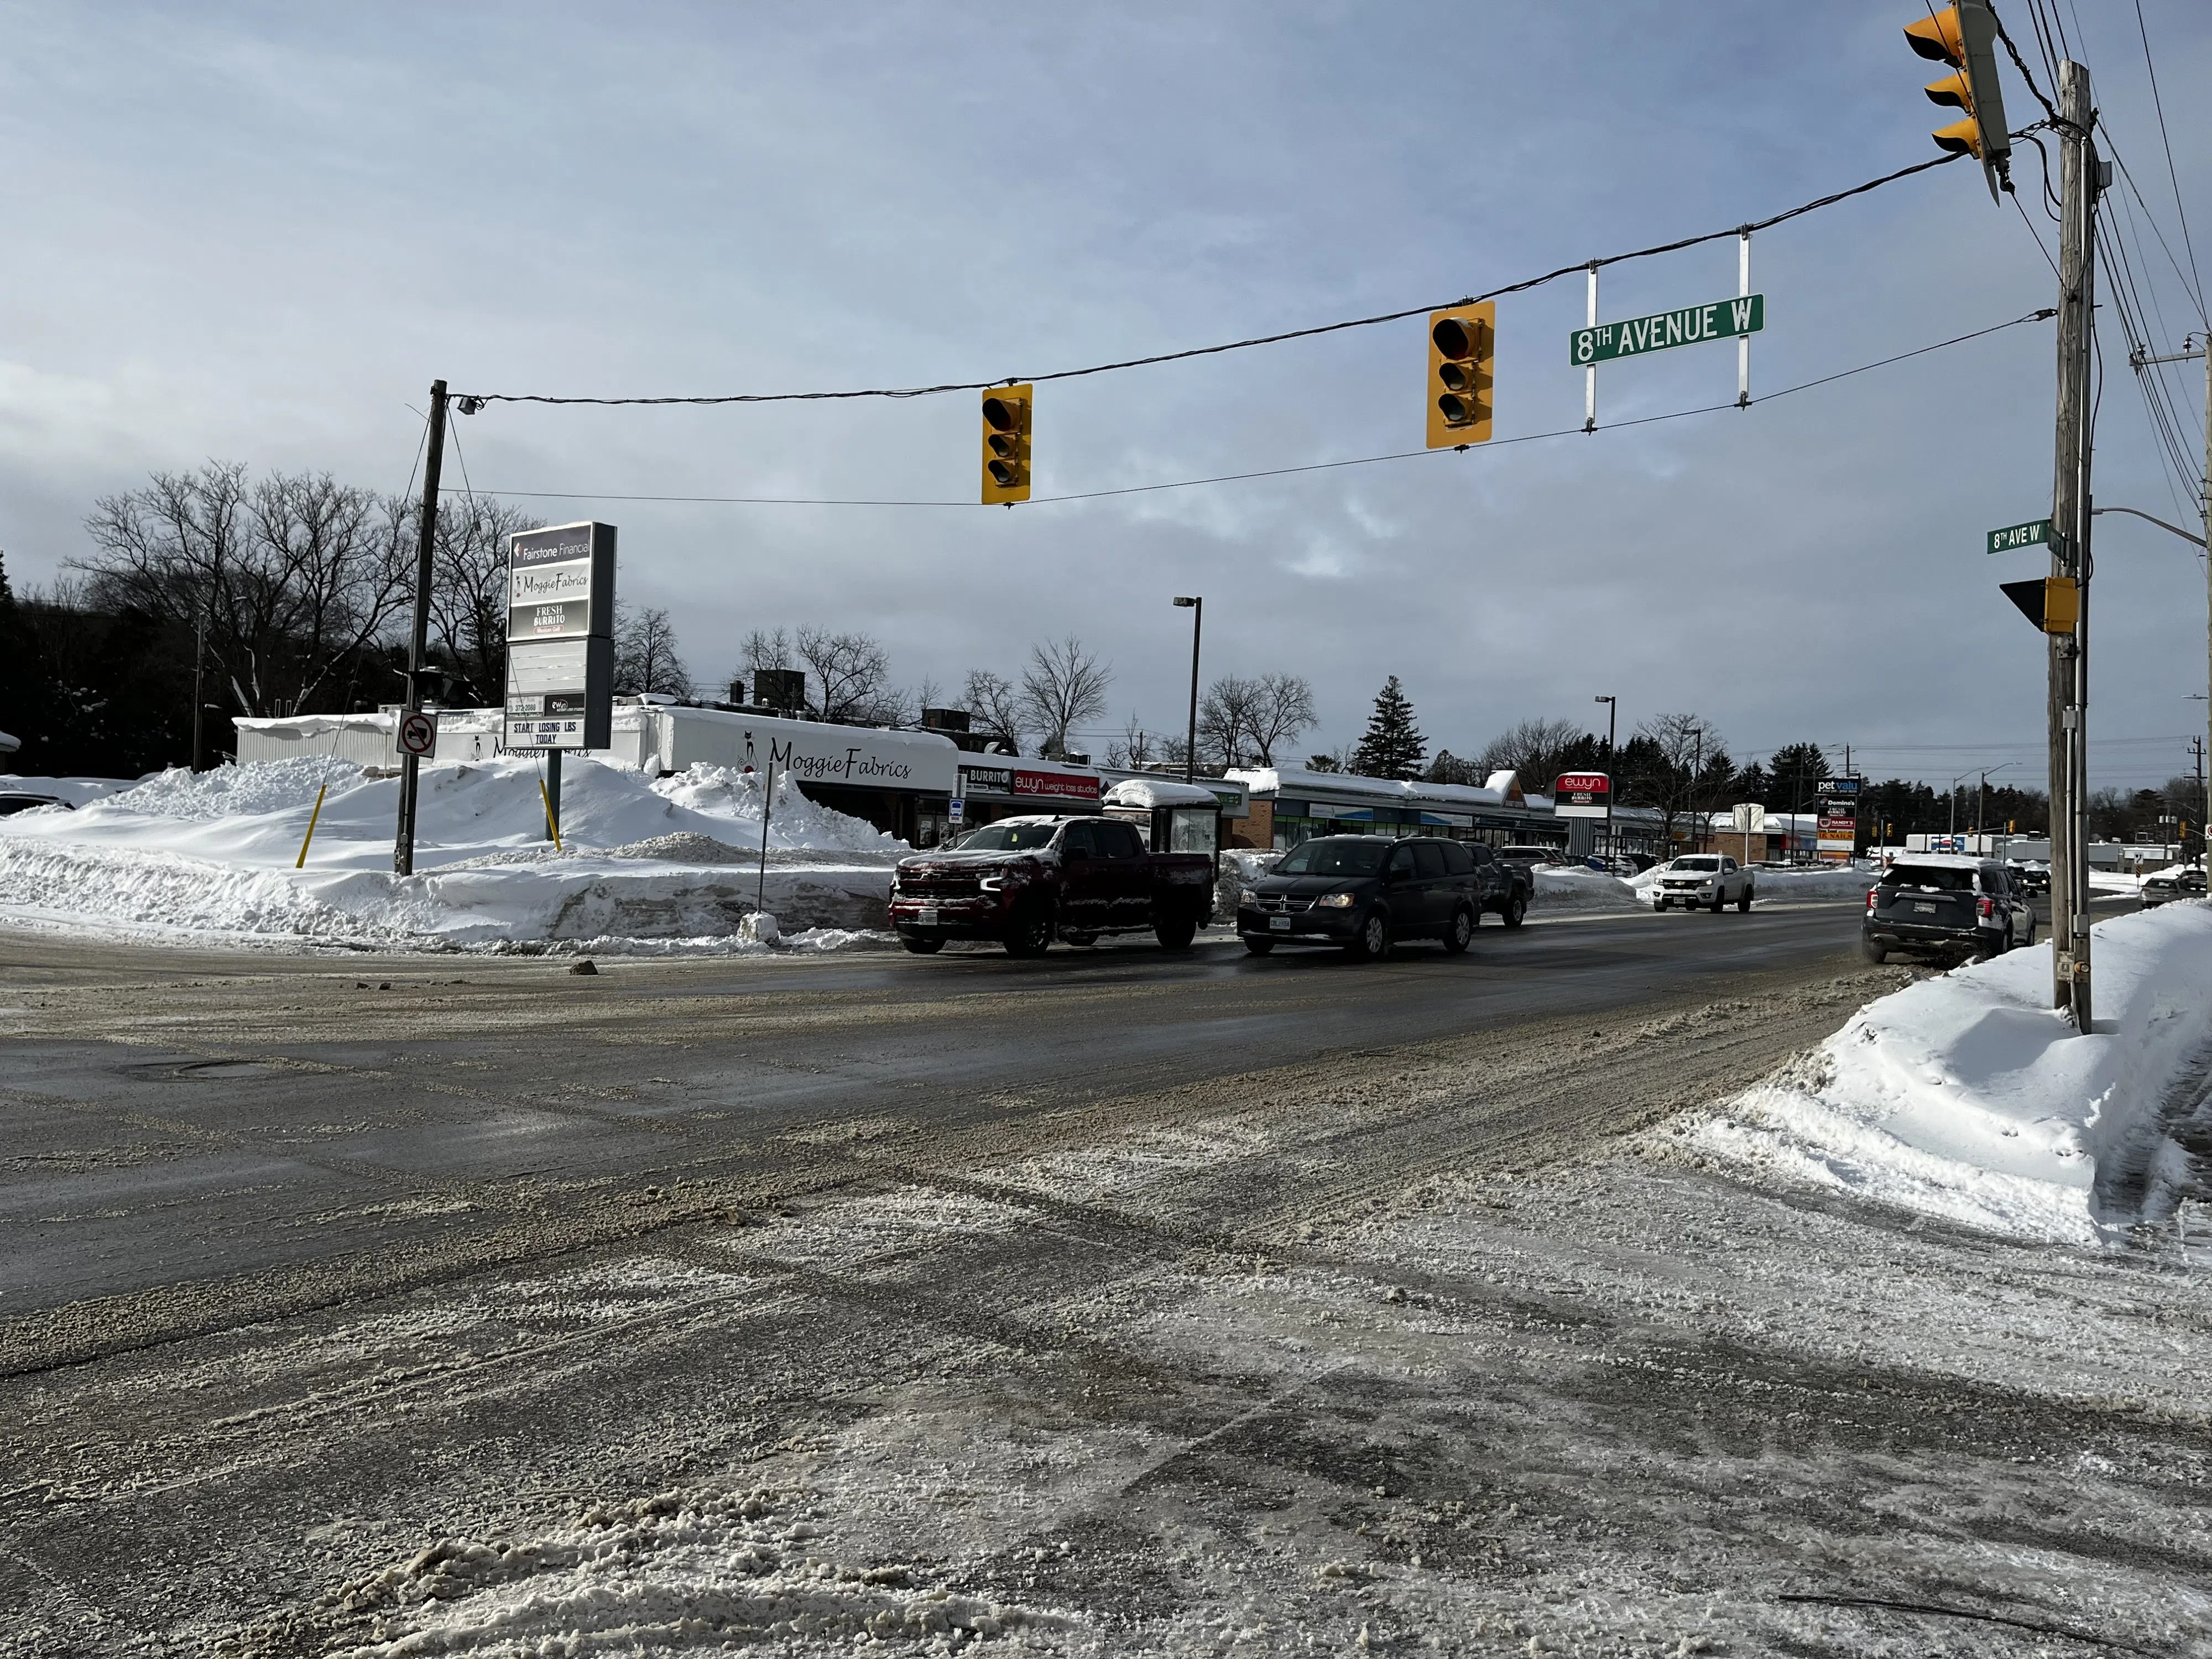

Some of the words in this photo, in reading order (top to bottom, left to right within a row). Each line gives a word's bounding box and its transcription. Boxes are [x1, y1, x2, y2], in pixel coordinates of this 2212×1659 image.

[1578, 326, 1611, 361] 8TH
[1618, 305, 1718, 354] AVENUE
[1731, 298, 1752, 332] W
[1994, 531, 2007, 549] 8TH
[2008, 527, 2027, 546] AVE
[2030, 525, 2039, 541] W
[523, 547, 557, 560] Fairstone
[559, 539, 590, 555] Financial
[536, 605, 562, 616] FRESH
[534, 615, 565, 627] BURRITO
[514, 723, 534, 733] START
[539, 722, 560, 732] LOSING
[565, 722, 576, 731] LBS
[535, 734, 556, 744] TODAY
[971, 770, 1008, 783] BURRITO
[1015, 777, 1043, 792] ewyn
[1045, 783, 1065, 792] weight
[1066, 783, 1076, 792] loss
[1077, 785, 1097, 794] studios
[1565, 778, 1600, 790] ewyn
[1818, 780, 1835, 792] pet
[1836, 781, 1858, 790] valu
